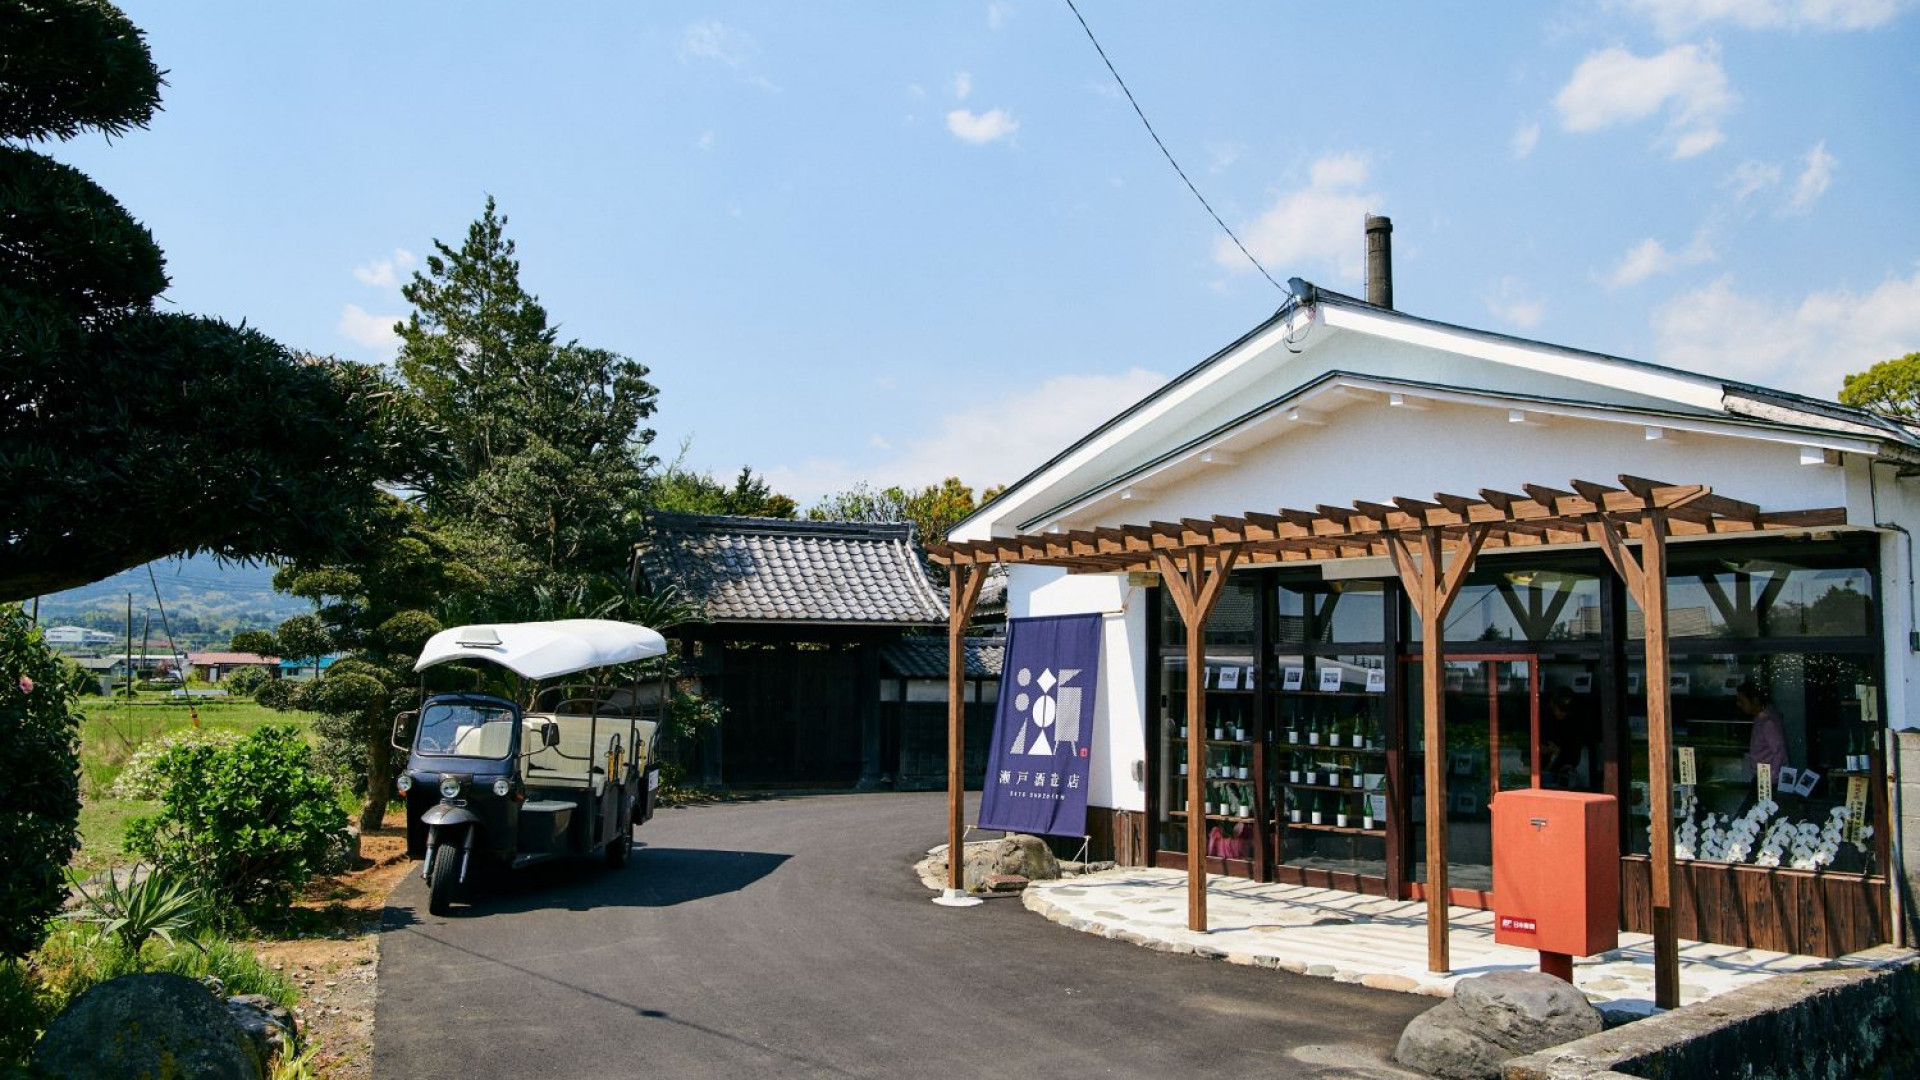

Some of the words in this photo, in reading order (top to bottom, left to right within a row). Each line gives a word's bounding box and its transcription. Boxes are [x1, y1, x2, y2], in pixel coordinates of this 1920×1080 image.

[999, 770, 1080, 788] 瀬戸酒造店
